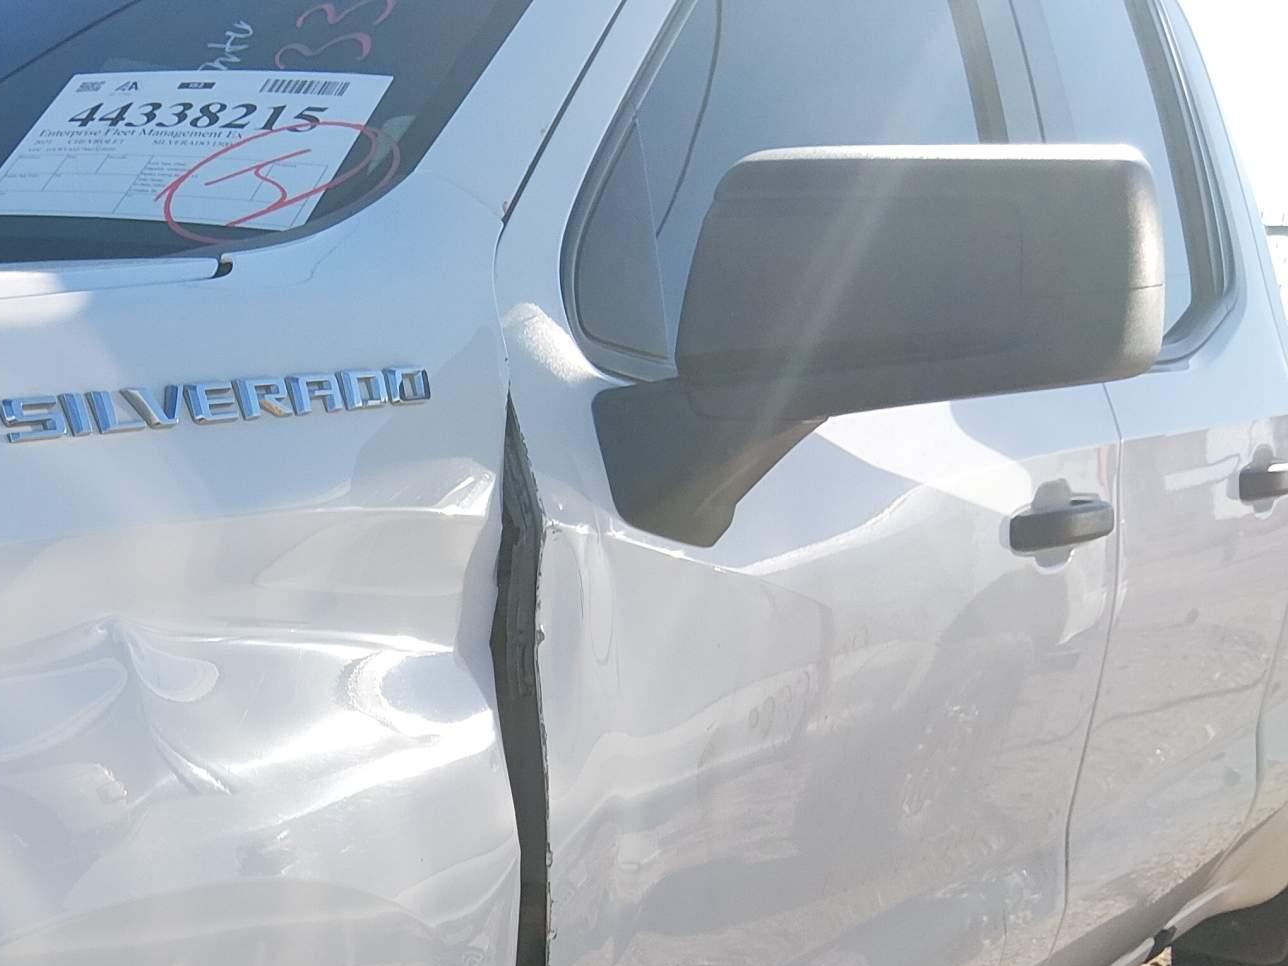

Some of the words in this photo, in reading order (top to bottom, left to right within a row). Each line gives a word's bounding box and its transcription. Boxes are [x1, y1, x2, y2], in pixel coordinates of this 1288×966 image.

[69, 102, 329, 132] 44338215
[38, 128, 101, 139] Enterprise
[102, 129, 134, 138] Fleet
[136, 128, 225, 139] Management
